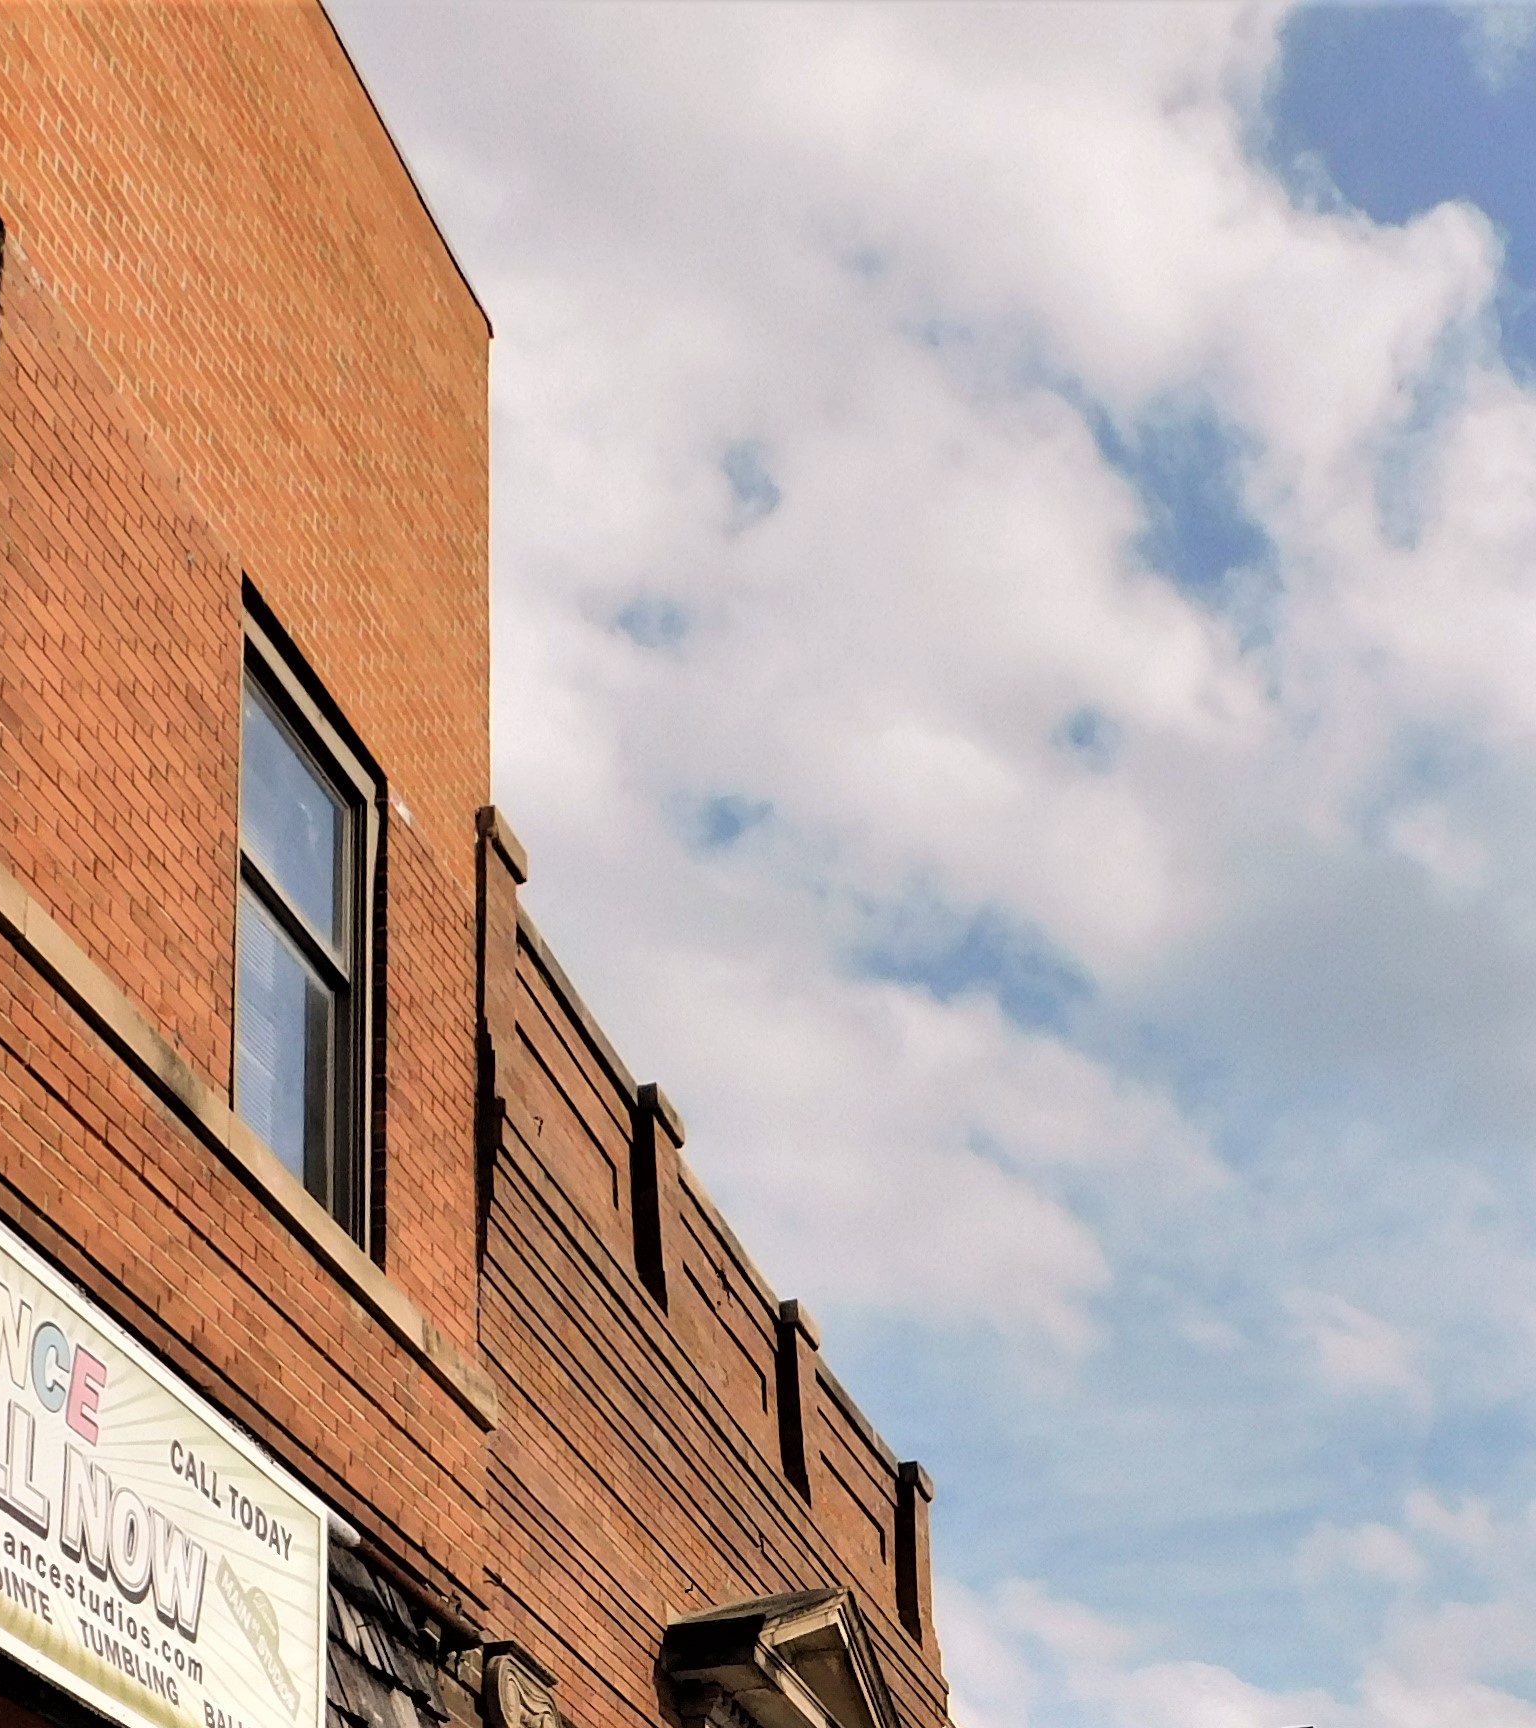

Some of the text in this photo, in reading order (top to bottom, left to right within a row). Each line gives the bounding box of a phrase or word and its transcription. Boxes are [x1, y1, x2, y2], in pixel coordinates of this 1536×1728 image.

[61, 1441, 207, 1644] NOW
[170, 1439, 293, 1561] CALL TODAY
[78, 1616, 180, 1708] TUMBLING
